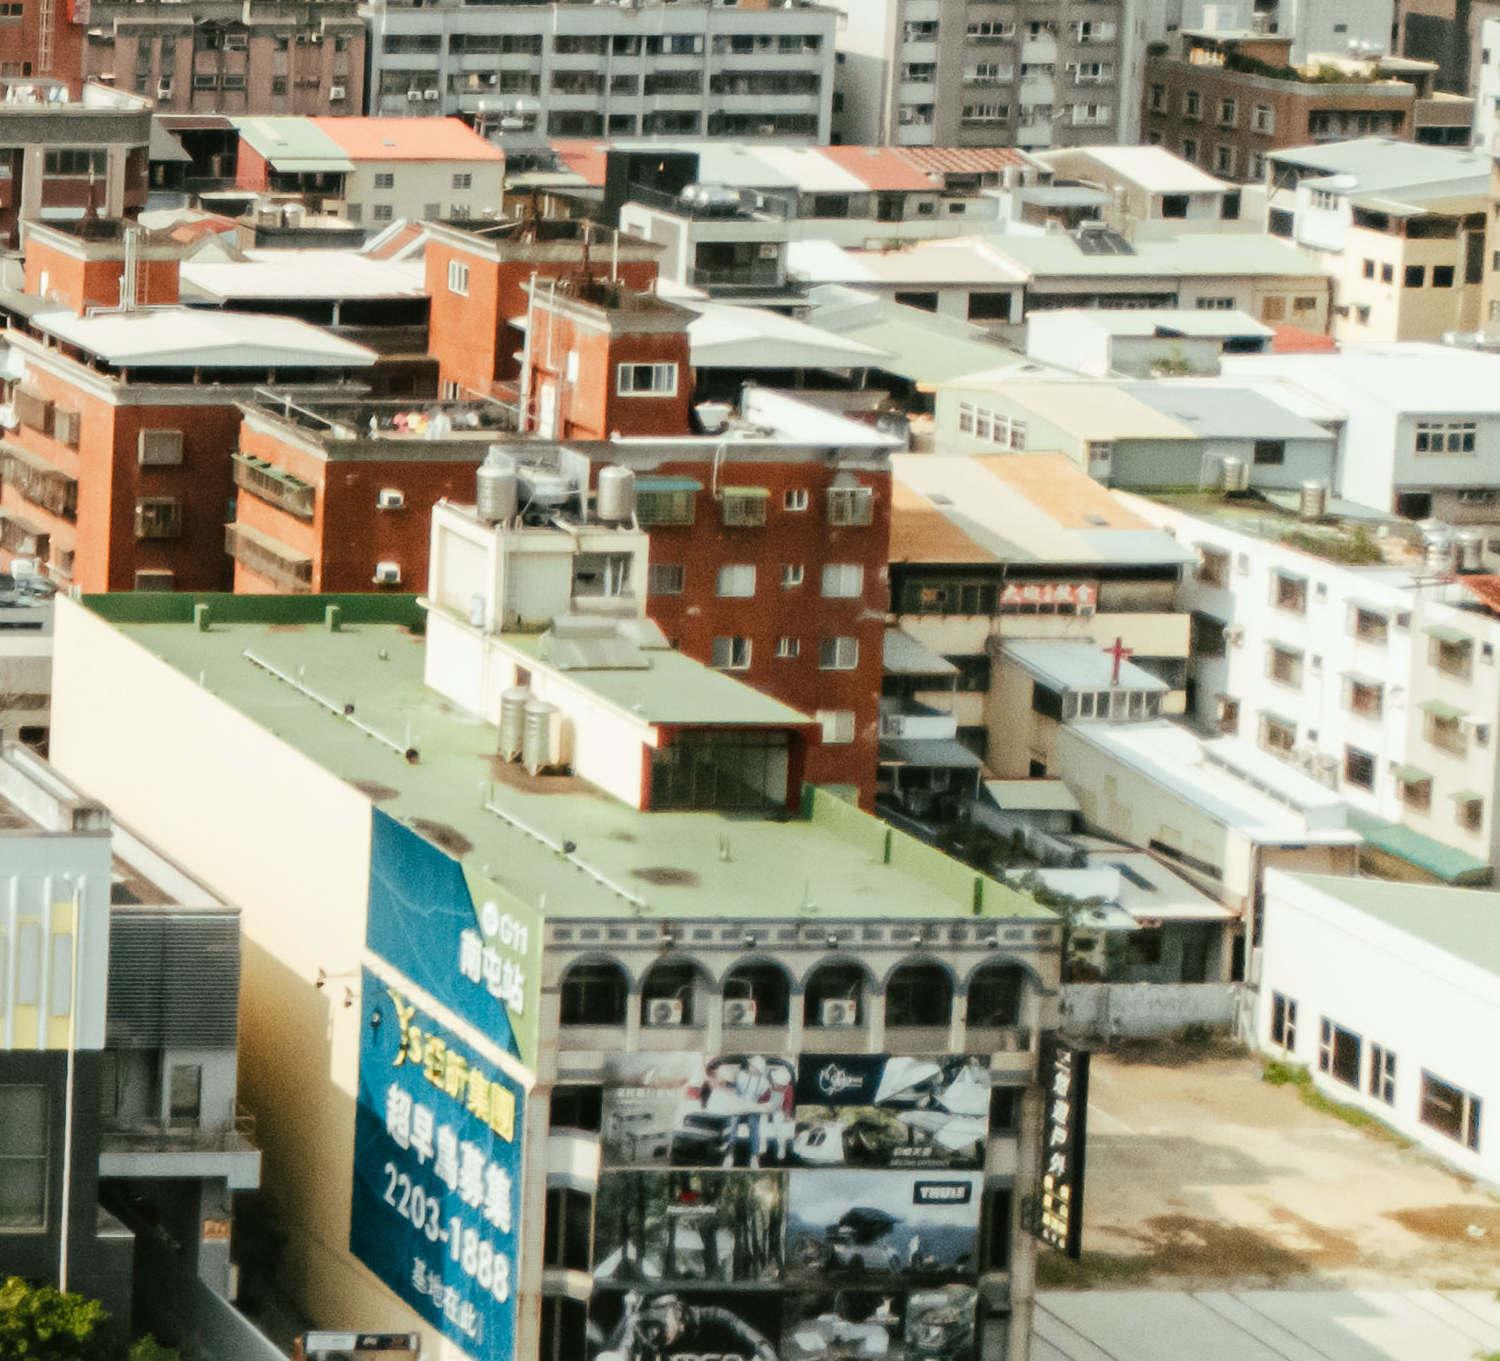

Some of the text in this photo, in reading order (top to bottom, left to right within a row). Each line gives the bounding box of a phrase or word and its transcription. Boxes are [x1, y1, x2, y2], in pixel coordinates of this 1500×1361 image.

[459, 929, 524, 1015] 南屯站
[500, 913, 528, 955] G11
[385, 1082, 512, 1234] 超早鳥募集
[384, 1162, 509, 1303] 2203-1888
